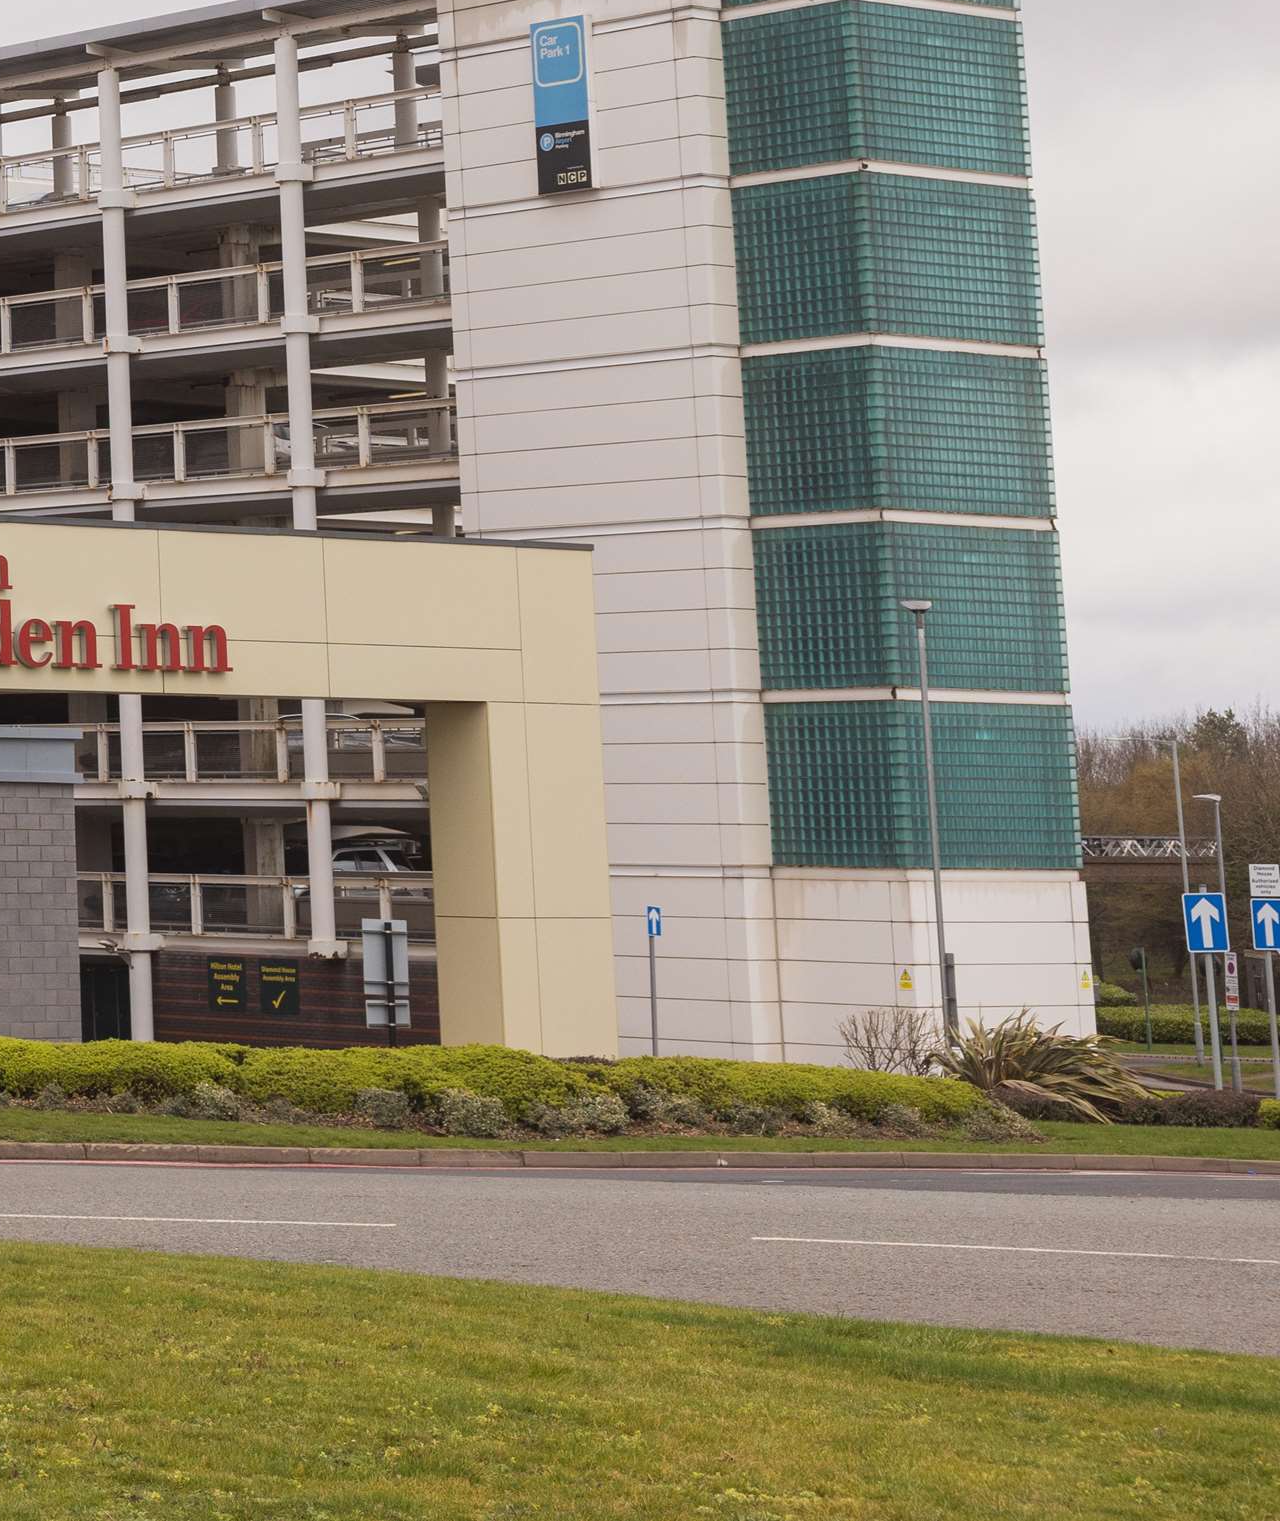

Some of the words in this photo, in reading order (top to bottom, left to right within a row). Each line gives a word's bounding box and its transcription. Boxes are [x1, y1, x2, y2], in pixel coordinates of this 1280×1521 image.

[540, 35, 557, 47] Car
[541, 46, 563, 59] Park
[565, 44, 570, 55] 1
[558, 170, 587, 184] NCP
[110, 603, 233, 673] Inn
